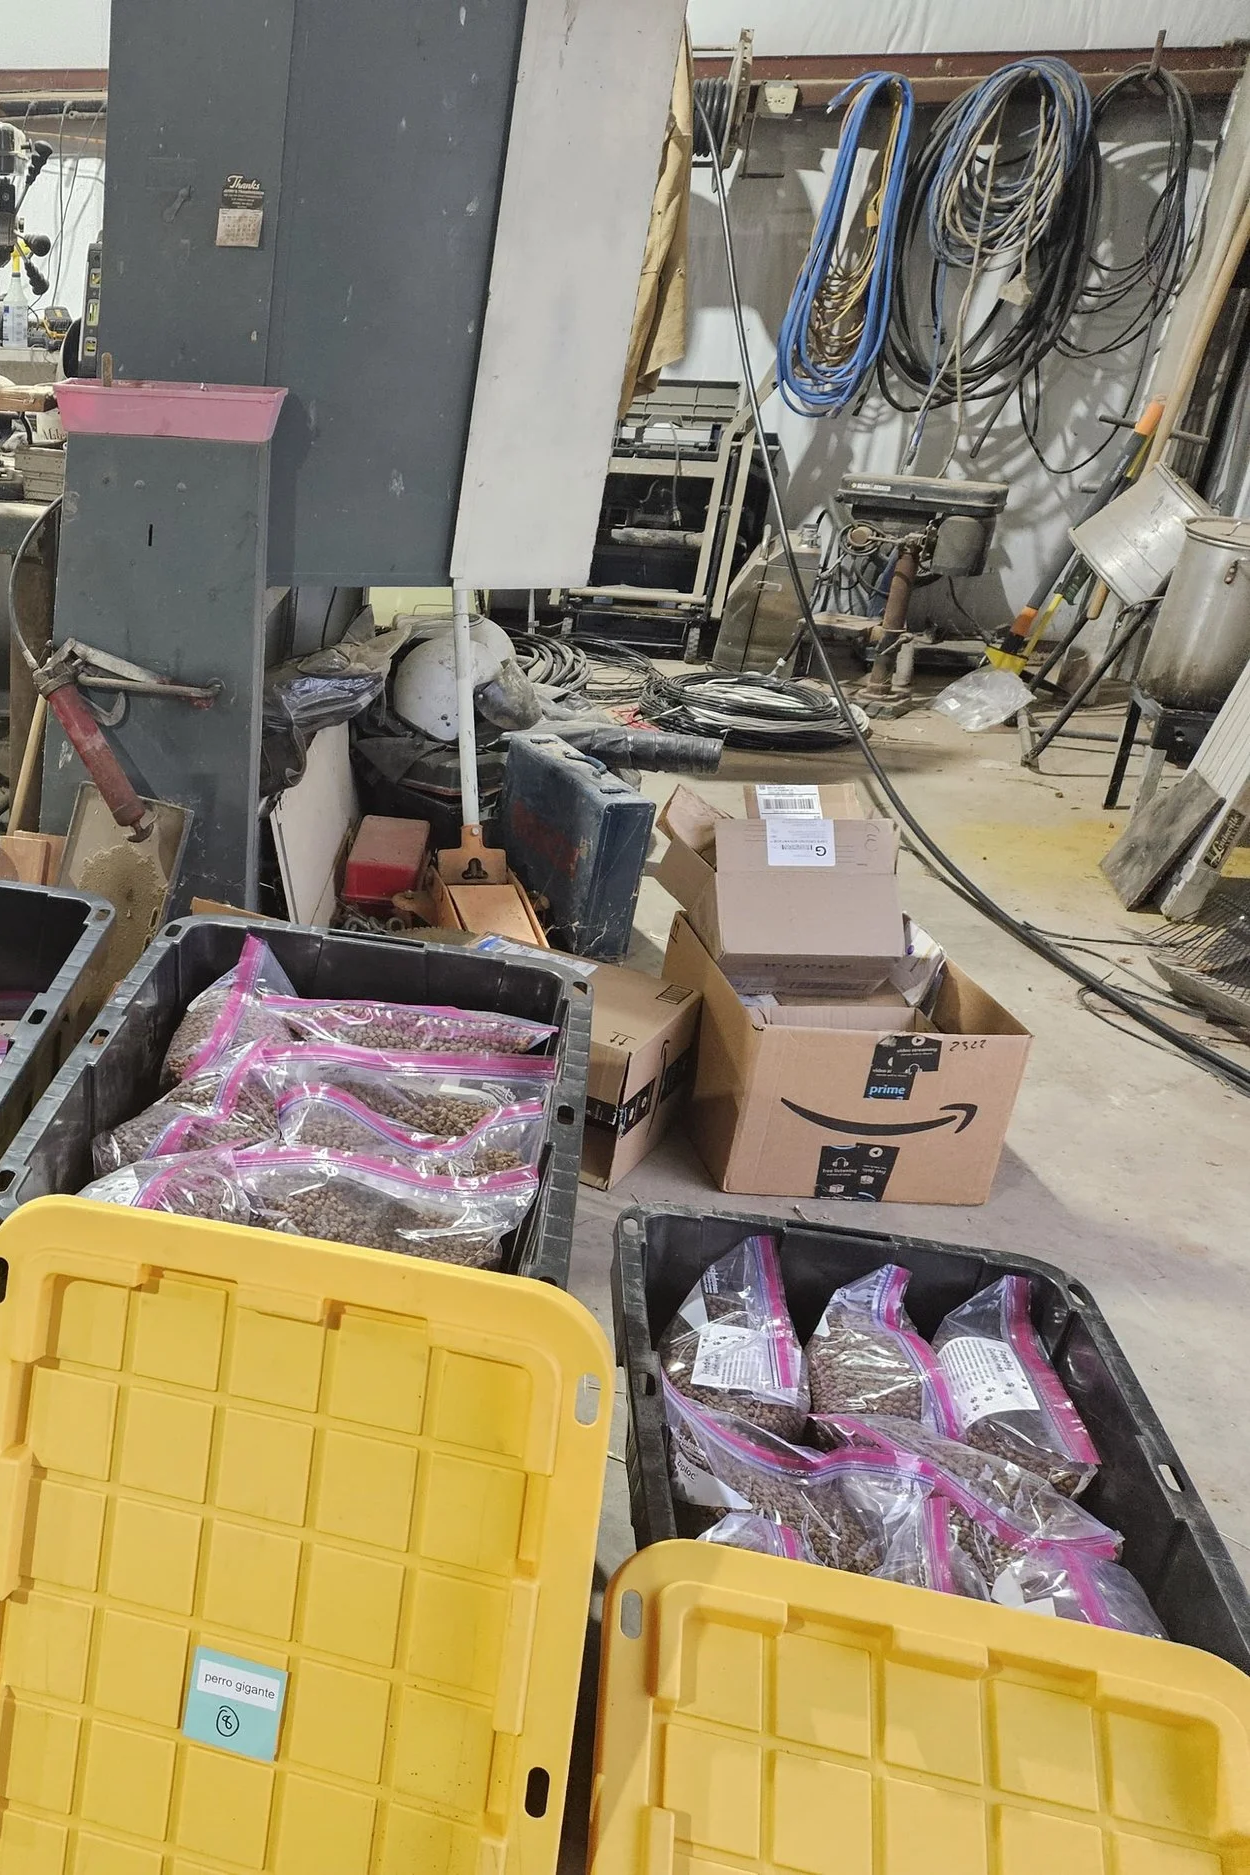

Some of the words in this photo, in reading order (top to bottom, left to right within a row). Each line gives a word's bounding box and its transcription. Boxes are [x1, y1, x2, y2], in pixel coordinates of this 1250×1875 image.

[227, 174, 261, 190] Thanks
[815, 846, 827, 857] G
[869, 1084, 906, 1095] prime
[204, 1673, 233, 1687] perro
[235, 1681, 275, 1700] gigante
